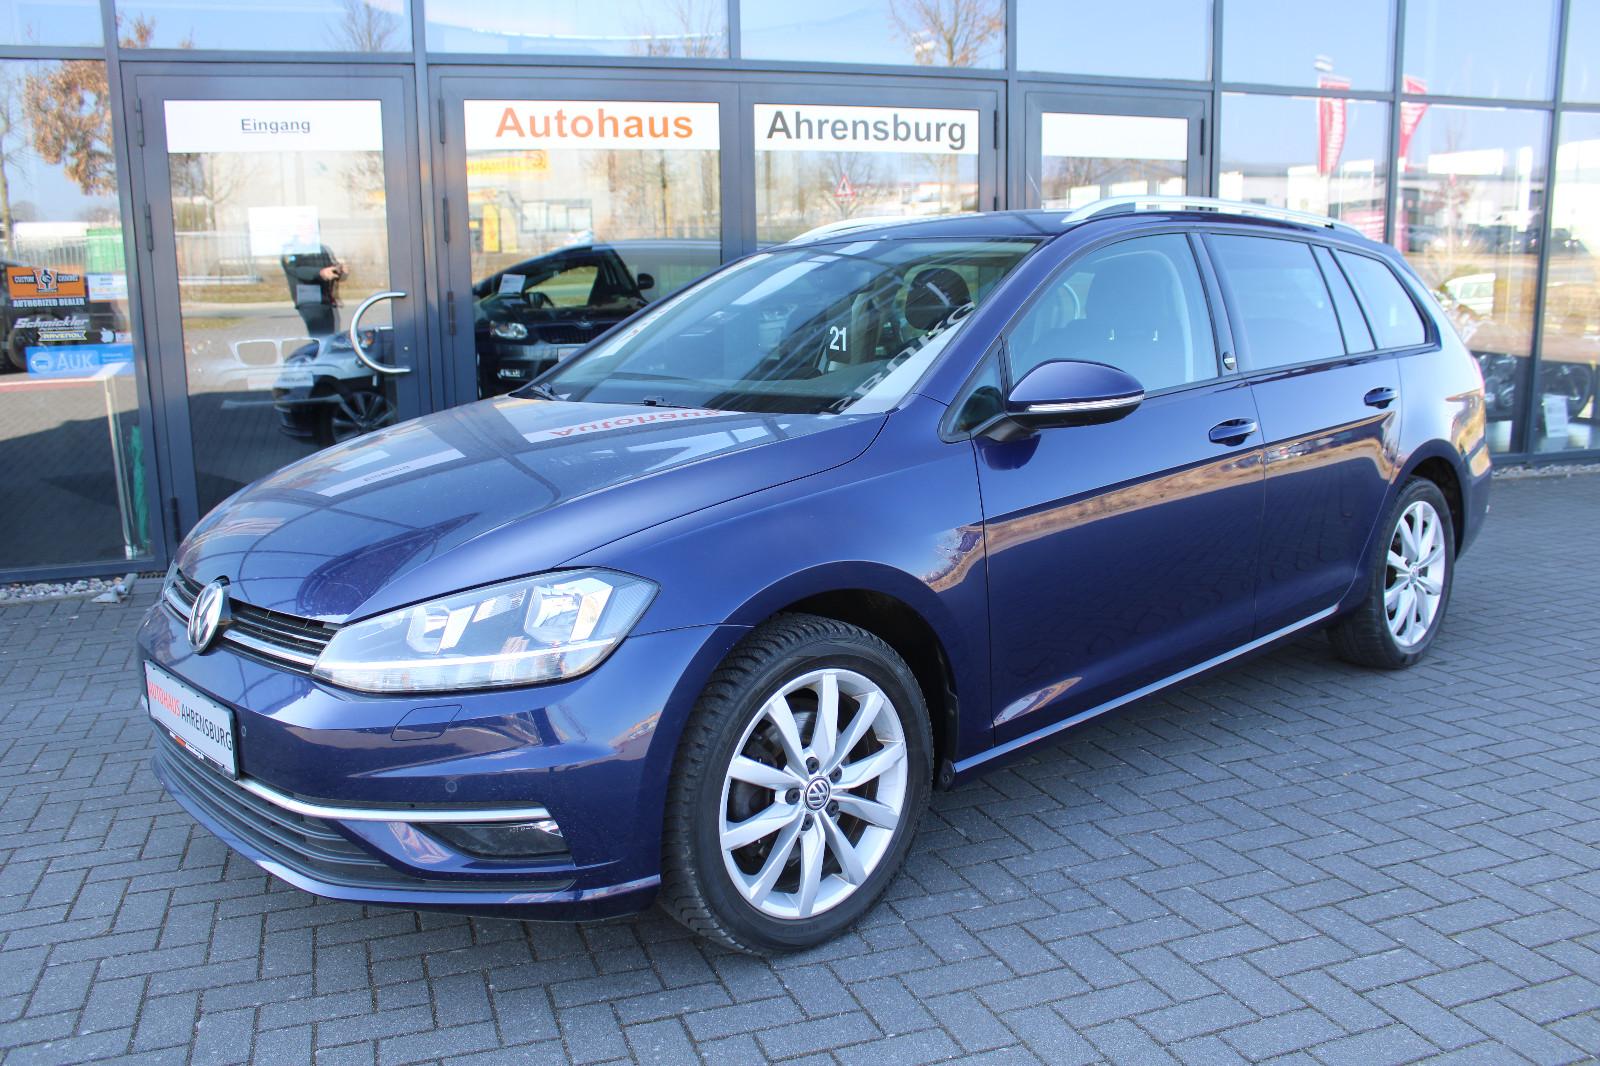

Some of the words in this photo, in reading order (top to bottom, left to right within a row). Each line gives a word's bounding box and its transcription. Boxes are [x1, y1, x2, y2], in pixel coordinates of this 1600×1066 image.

[241, 118, 310, 134] Eingang
[496, 107, 693, 138] Autohaus
[766, 110, 966, 151] Ahrensburg
[13, 299, 58, 307] AUTHORIZED
[60, 298, 85, 306] DEALER
[14, 315, 90, 329] Schmickler
[829, 326, 847, 351] 21
[56, 352, 95, 369] AUK
[147, 682, 181, 718] AUTOHAUS
[181, 703, 233, 751] AHRENSBURG
